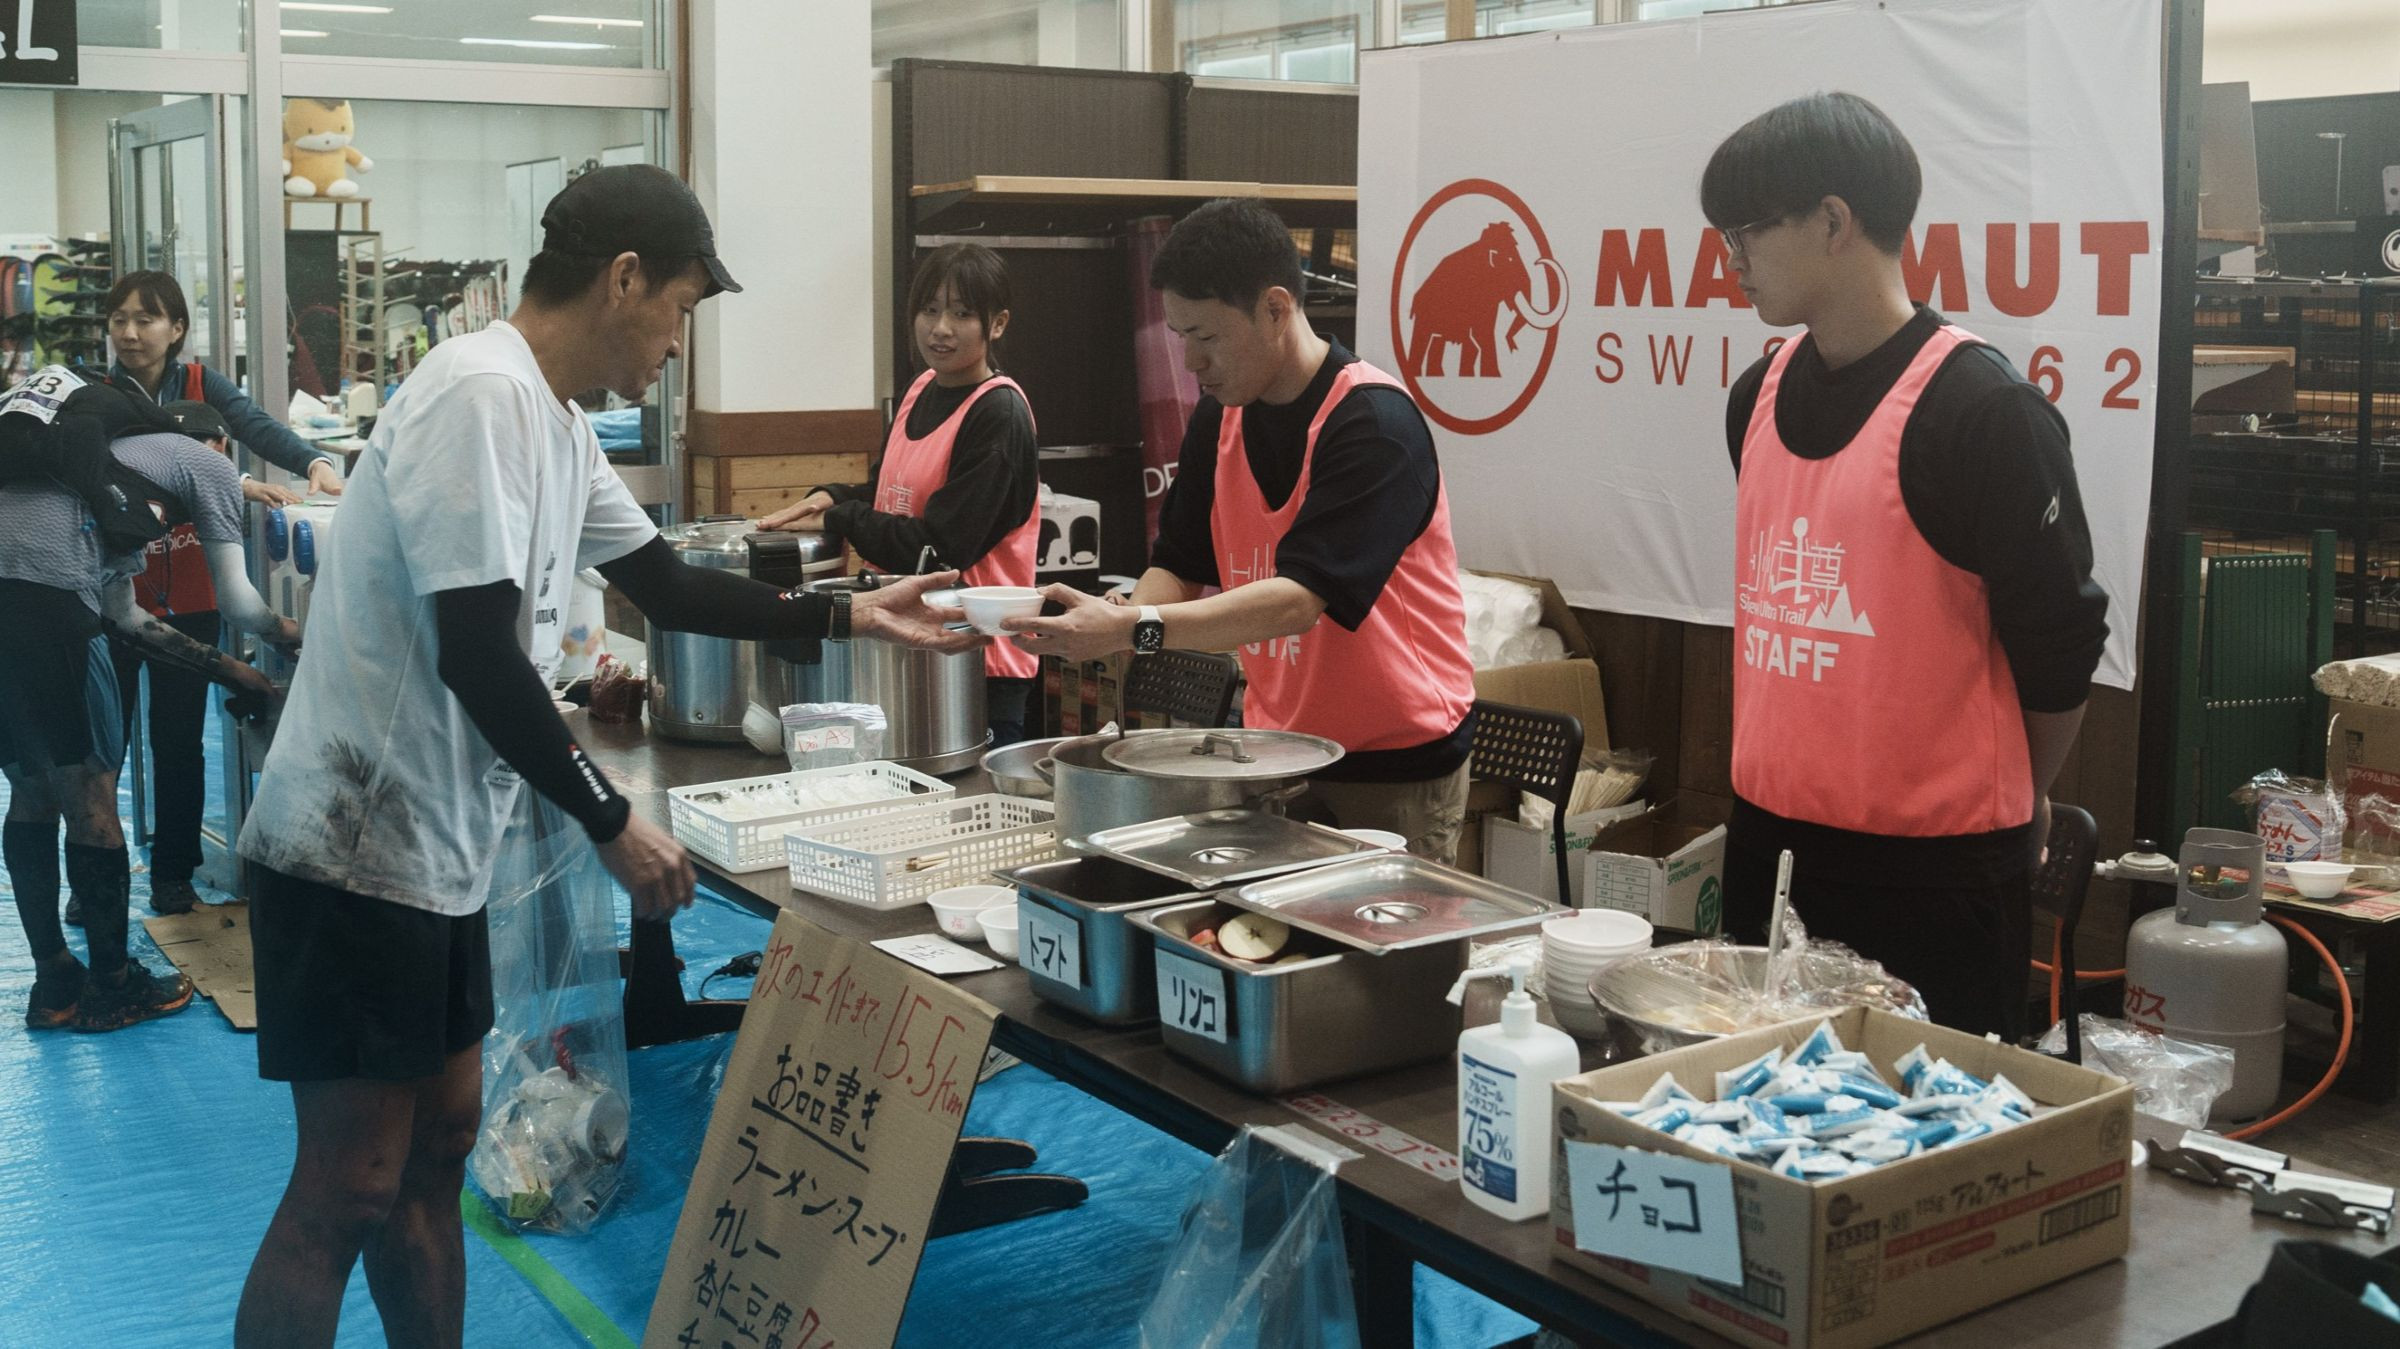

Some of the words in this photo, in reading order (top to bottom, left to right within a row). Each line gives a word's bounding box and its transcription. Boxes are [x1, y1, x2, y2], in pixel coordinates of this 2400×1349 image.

[1594, 221, 2150, 318] MAMUT
[1594, 331, 1790, 389] SWI
[2028, 345, 2143, 410] 62
[1744, 624, 1840, 682] STAFF
[1778, 604, 1807, 626] Trail
[757, 937, 881, 1037] 次のエイドまで
[1029, 920, 1067, 979] トマト
[766, 1043, 883, 1153] お品書き
[1464, 1105, 1513, 1162] 75%
[708, 1199, 781, 1259] カレー
[1596, 1157, 1703, 1234] チョコ
[693, 1257, 794, 1349] 杏仁豆腐
